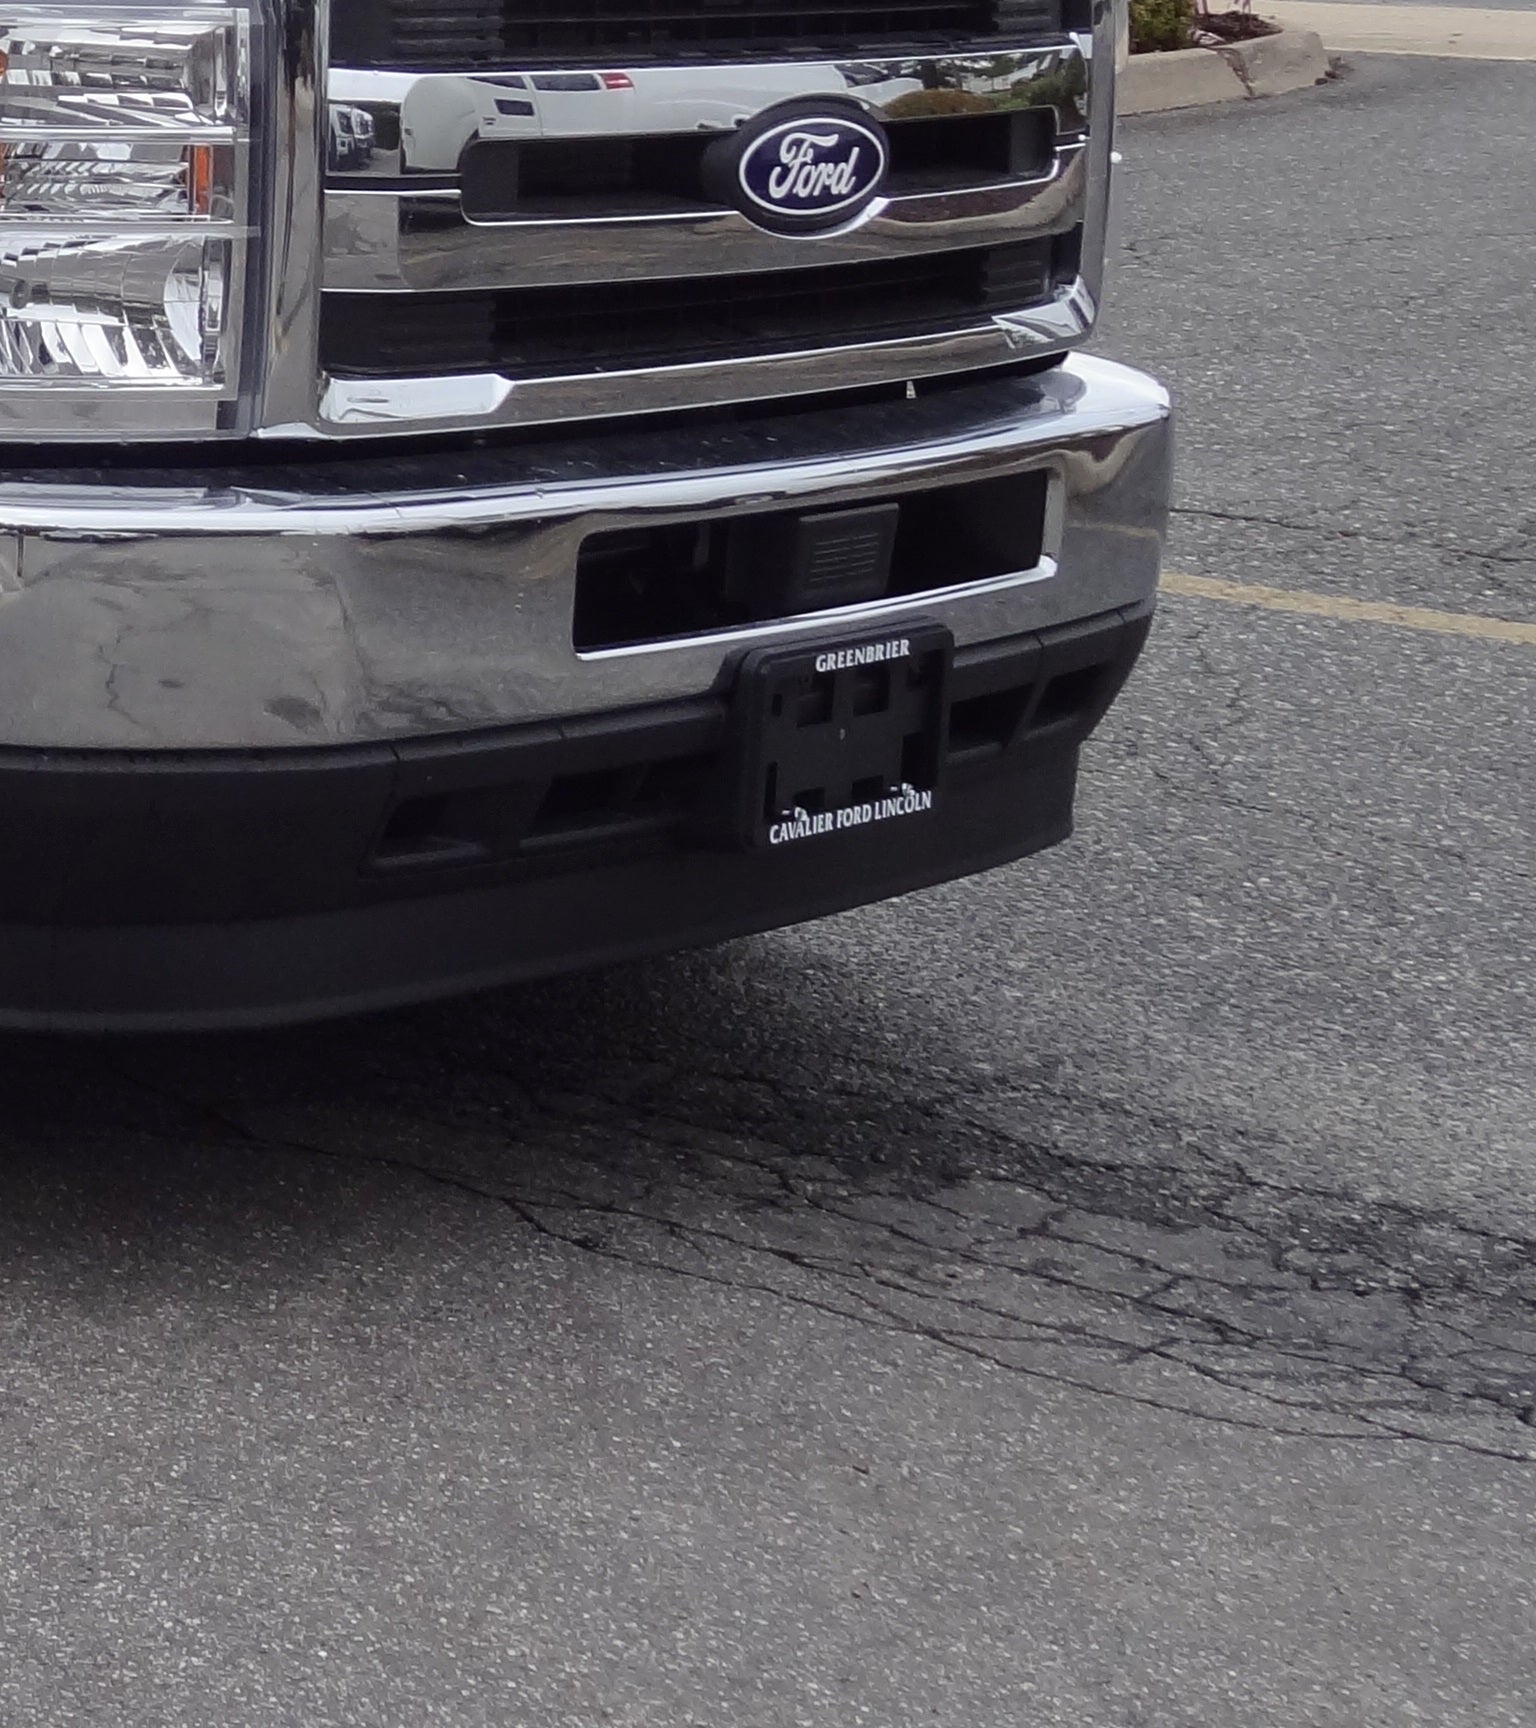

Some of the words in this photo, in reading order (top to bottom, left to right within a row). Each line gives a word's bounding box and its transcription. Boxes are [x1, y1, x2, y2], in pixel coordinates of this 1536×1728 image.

[768, 132, 860, 199] Ford
[815, 639, 911, 672] GREENBRIER
[769, 812, 834, 844] CAVALIER
[836, 803, 872, 829] FORD
[874, 790, 932, 820] LINCOLN
